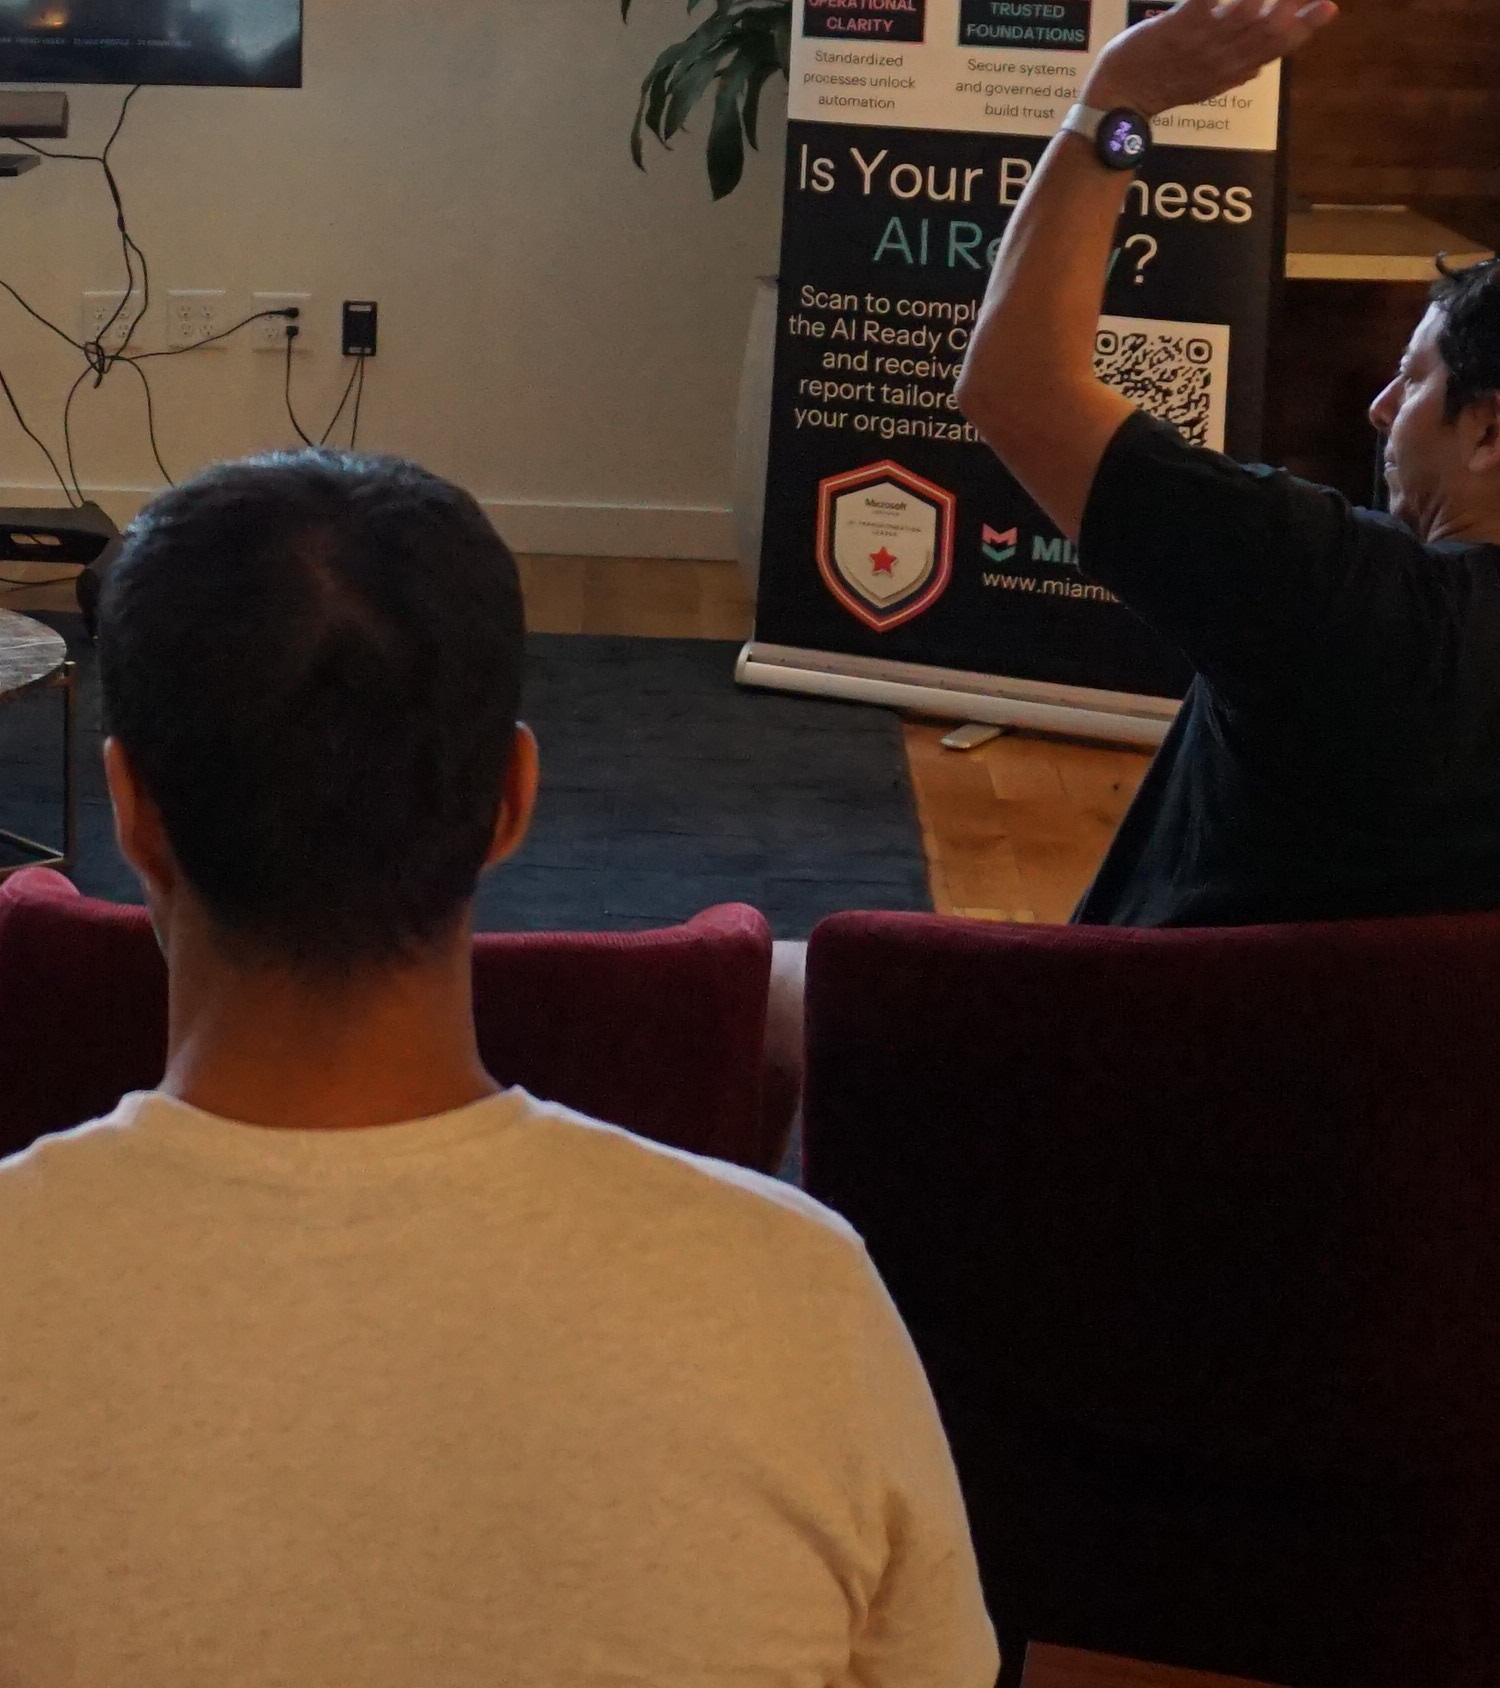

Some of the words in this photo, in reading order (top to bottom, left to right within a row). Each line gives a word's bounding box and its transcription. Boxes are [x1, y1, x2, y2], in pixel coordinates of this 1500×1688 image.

[990, 1, 1065, 18] TRUSTED
[826, 16, 894, 32] CLARITY
[966, 23, 1085, 42] FOUNDATIONS
[815, 50, 904, 66] Standardized
[967, 58, 1016, 72] Secure
[1019, 63, 1077, 77] systems
[803, 72, 867, 87] processes
[870, 75, 916, 89] unlock
[955, 81, 982, 93] and
[985, 83, 1050, 97] governed
[1054, 87, 1079, 98] dat
[818, 95, 895, 109] automation
[984, 102, 1019, 116] build
[1022, 105, 1055, 119] trust
[1231, 95, 1253, 109] for
[1152, 115, 1174, 127] eal
[1177, 118, 1231, 131] impact
[800, 143, 835, 192] Is
[850, 147, 984, 202] Your
[999, 157, 1253, 224] Bness
[873, 216, 929, 266] AI
[801, 285, 858, 311] Scan
[865, 293, 890, 314] to
[897, 299, 977, 325] compl
[789, 314, 825, 338] the
[831, 317, 856, 341] AI
[863, 320, 942, 353] Ready
[823, 350, 868, 372] and
[800, 378, 875, 402] report
[881, 383, 959, 410] tailore
[794, 407, 848, 429] your
